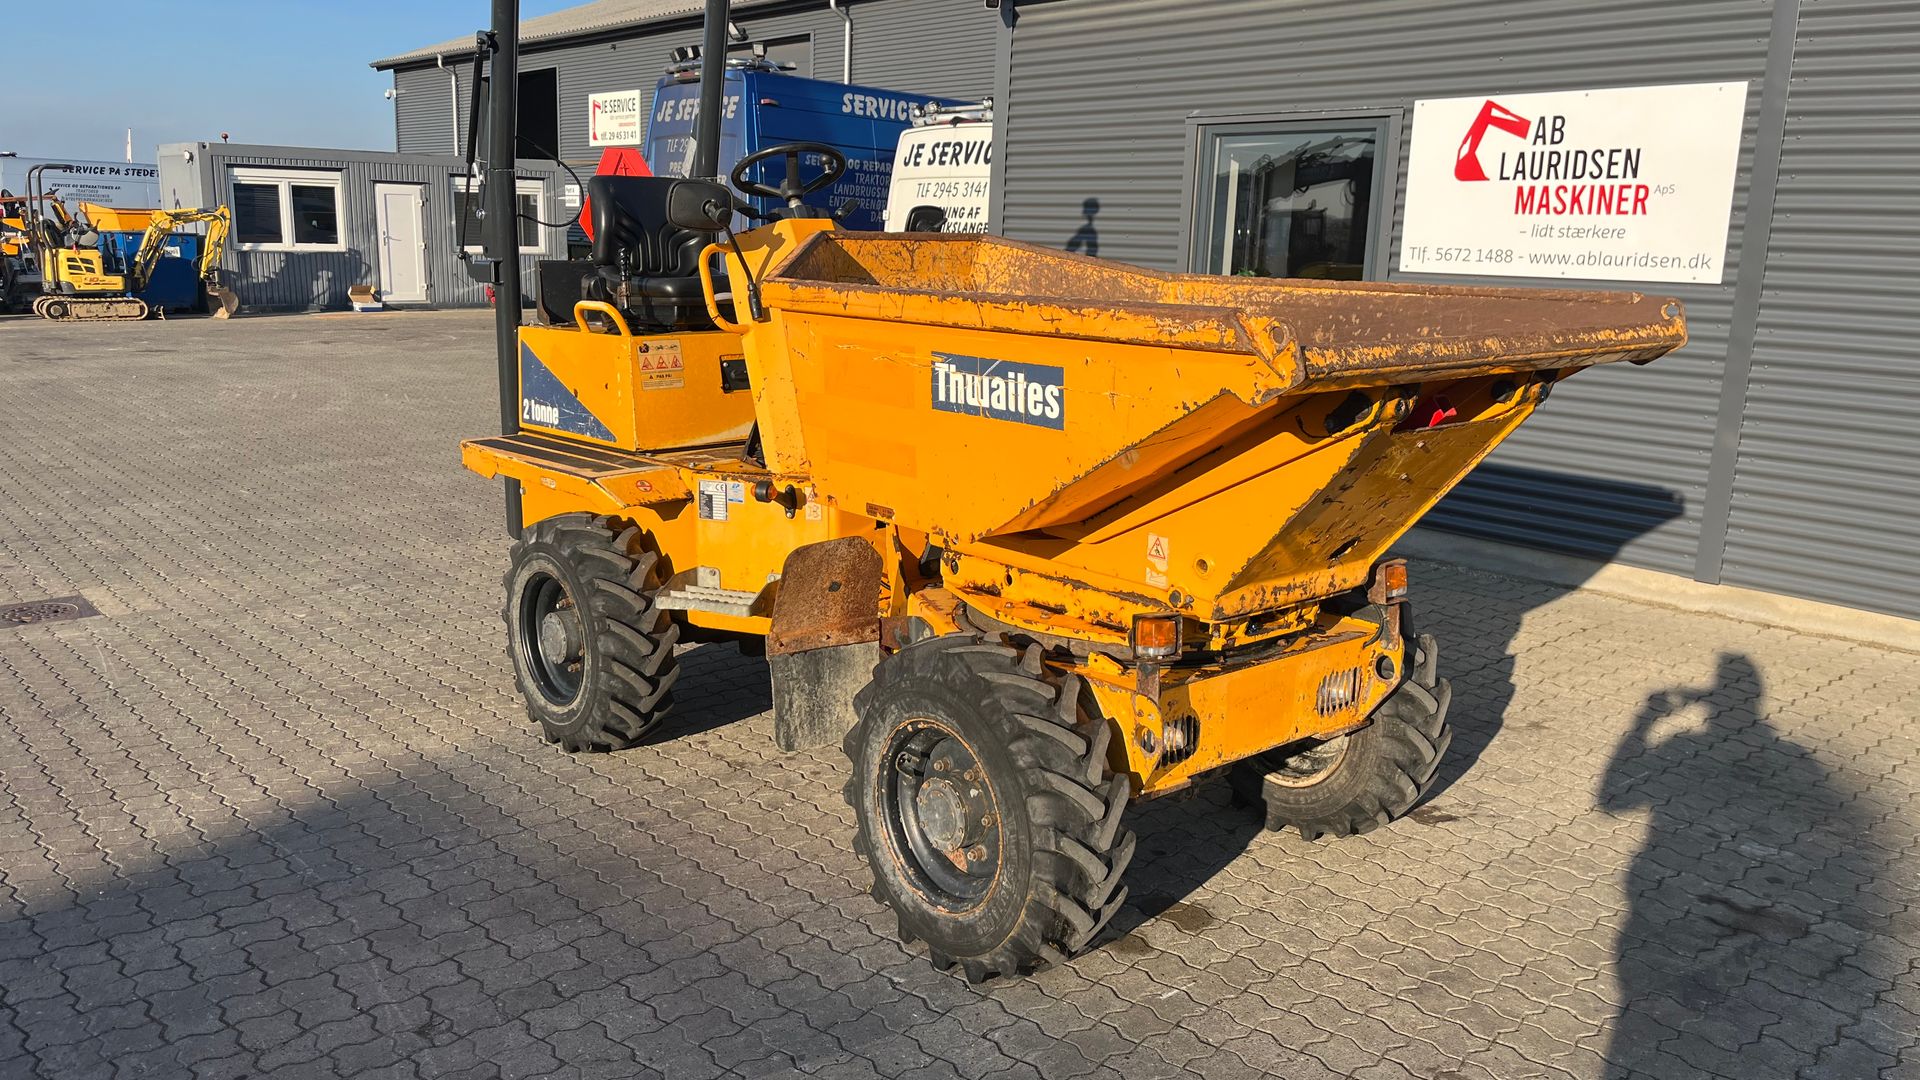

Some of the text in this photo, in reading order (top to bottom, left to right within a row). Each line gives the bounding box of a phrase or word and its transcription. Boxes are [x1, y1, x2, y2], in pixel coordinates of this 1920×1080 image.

[601, 97, 636, 114] JE SERVICE
[657, 96, 739, 122] JE SERCE
[1532, 115, 1566, 146] AB
[903, 140, 993, 168] JE SERVIC
[1499, 148, 1642, 181] LAURIDSEN
[847, 158, 861, 170] OG
[863, 160, 892, 174] REPAR
[833, 183, 889, 199] LANDBRUGSM
[855, 172, 891, 187] TRAKTOR
[916, 181, 988, 199] TLF 2945 3141
[1514, 184, 1676, 216] MASKINER ApS
[967, 206, 982, 220] AF
[1531, 224, 1555, 239] lidt
[1557, 226, 1627, 240] stærkere
[1409, 247, 1431, 264] Tlf.
[1435, 247, 1472, 262] 5672
[1475, 248, 1514, 264] 1488
[1528, 250, 1712, 270] www.ablauridsen.dk
[934, 361, 1061, 420] Thwaites
[523, 398, 560, 425] 2 tonne
